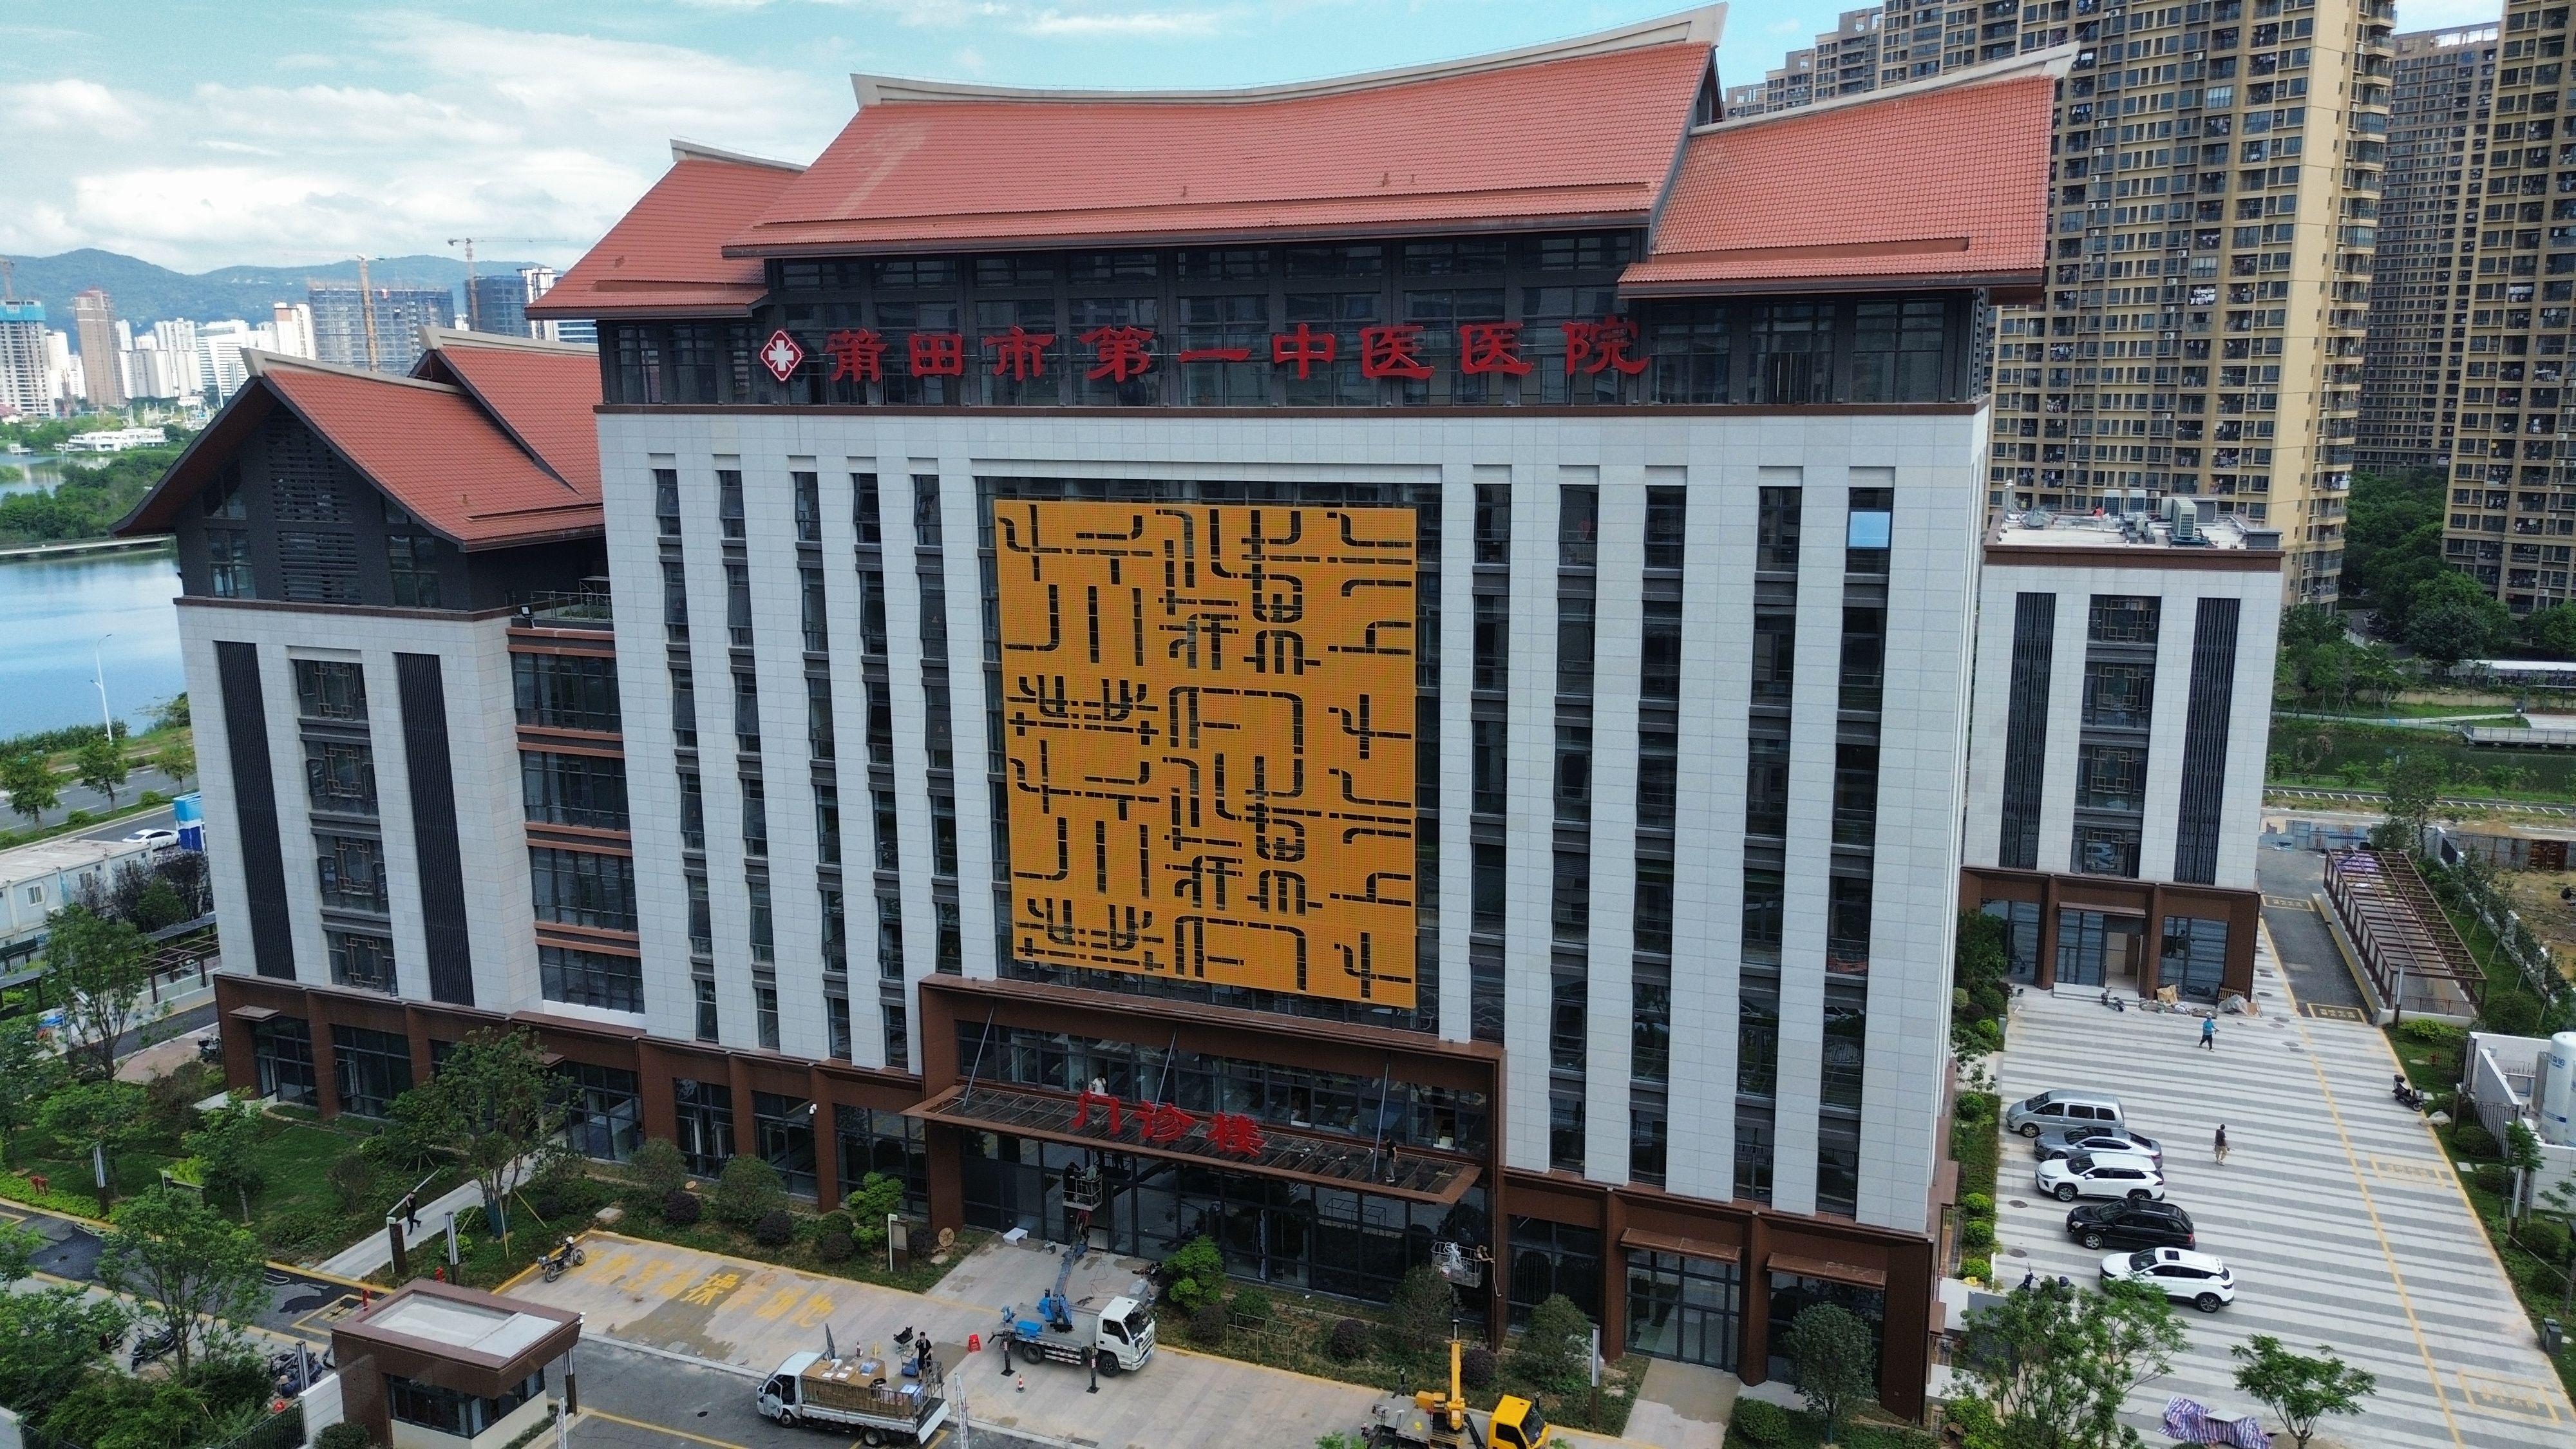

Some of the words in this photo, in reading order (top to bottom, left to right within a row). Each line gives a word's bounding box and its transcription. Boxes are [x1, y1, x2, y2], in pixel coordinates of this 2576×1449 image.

[827, 317, 1651, 382] 莆田市第一中医医院
[1070, 1089, 1266, 1157] 门诊楼
